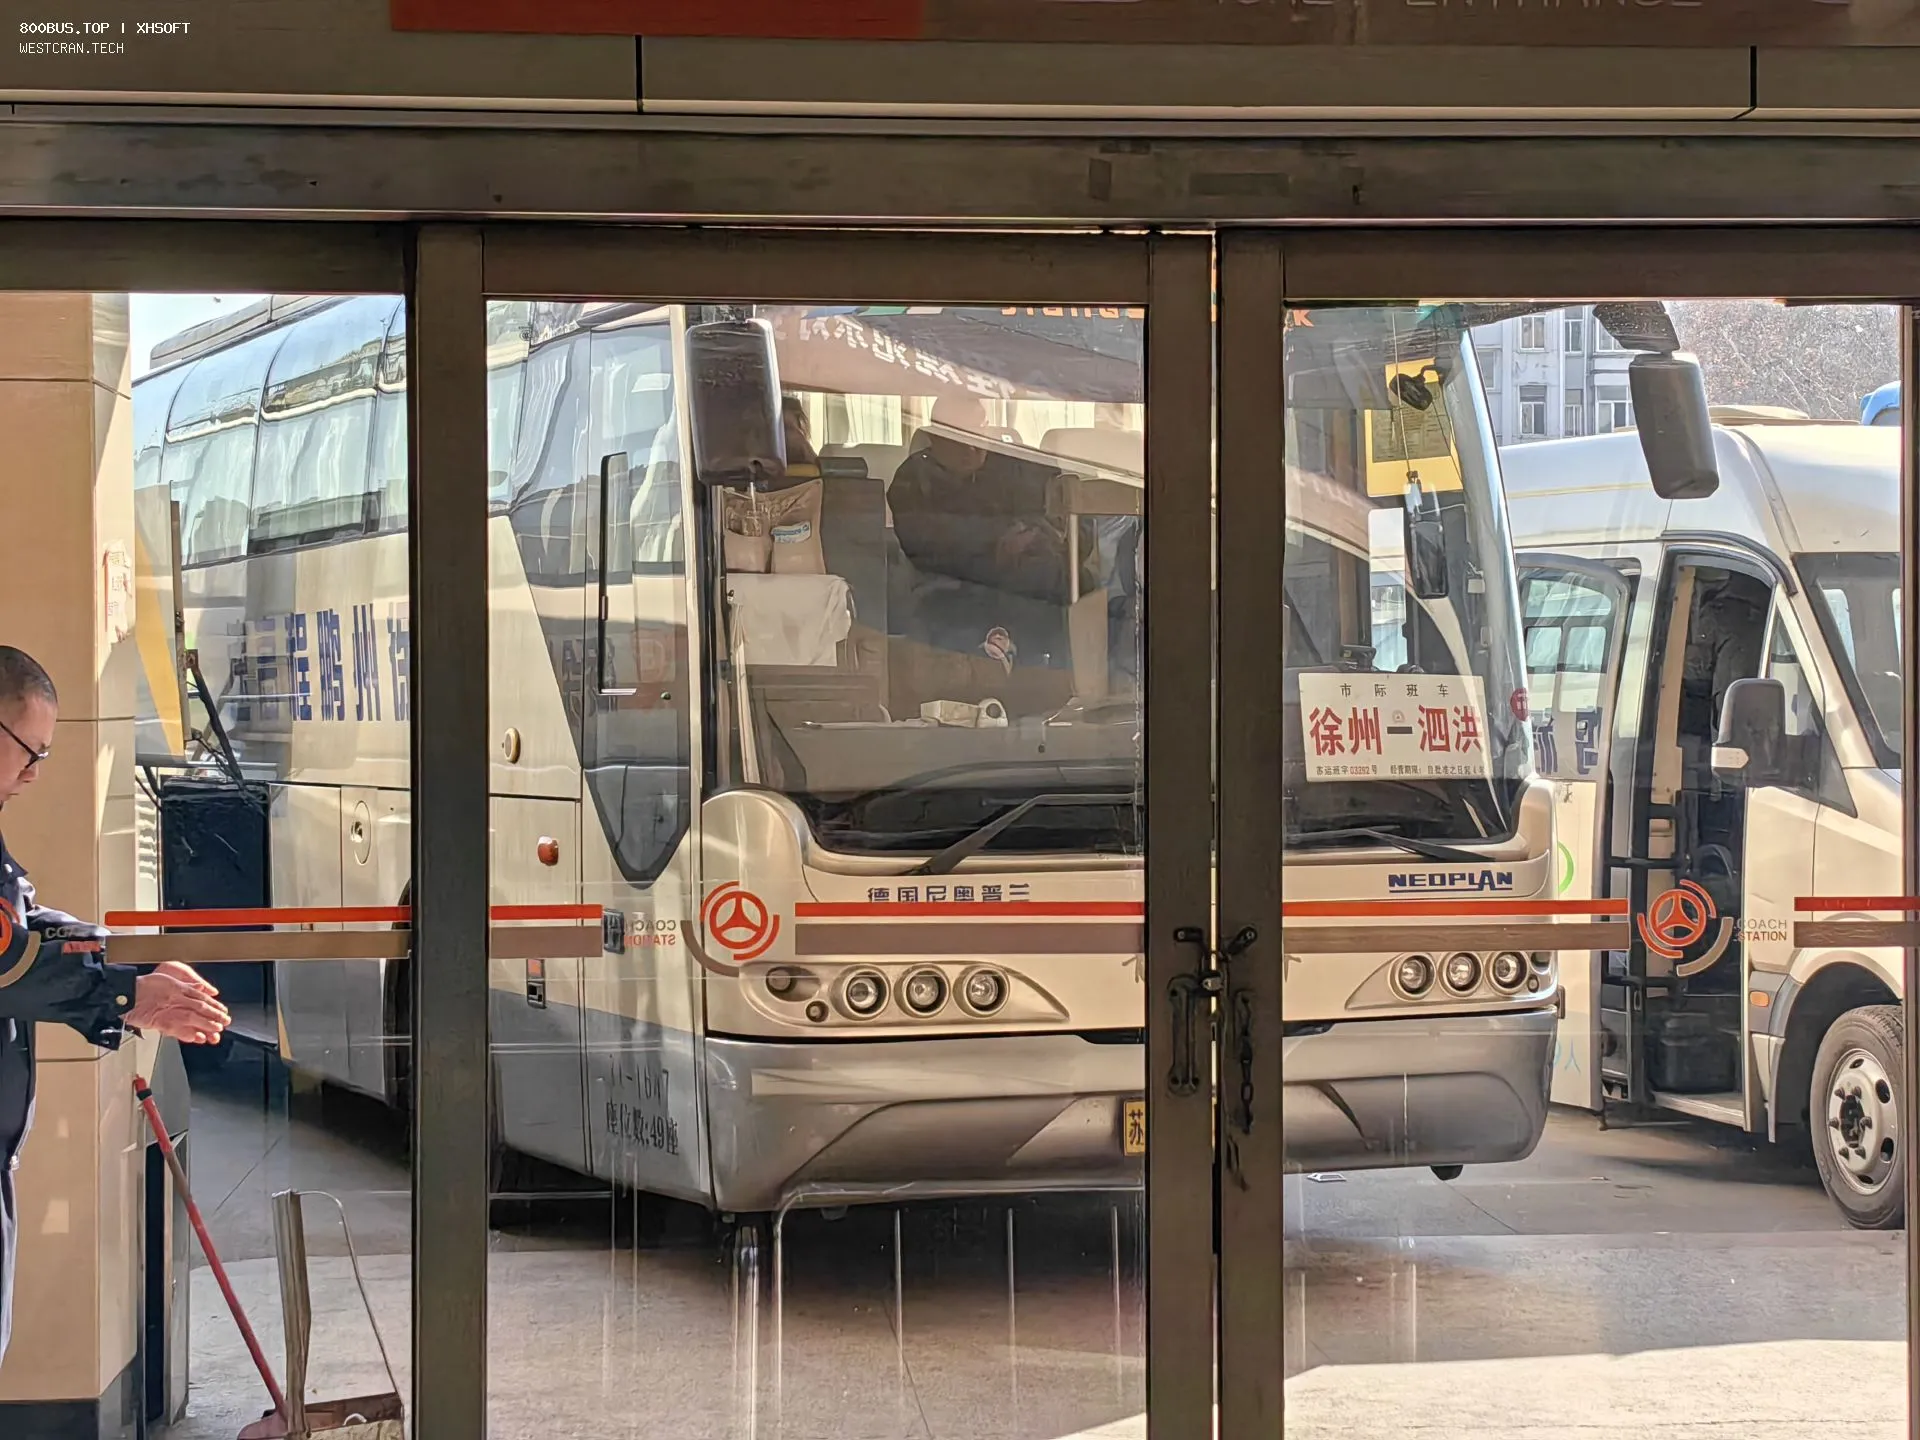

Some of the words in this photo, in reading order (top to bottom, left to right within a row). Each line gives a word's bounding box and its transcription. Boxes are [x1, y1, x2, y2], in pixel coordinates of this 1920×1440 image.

[1340, 683, 1450, 698] 市际班车
[1388, 869, 1513, 893] NEOPLAN
[1736, 918, 1787, 930] COACH
[1737, 931, 1787, 941] STATION
